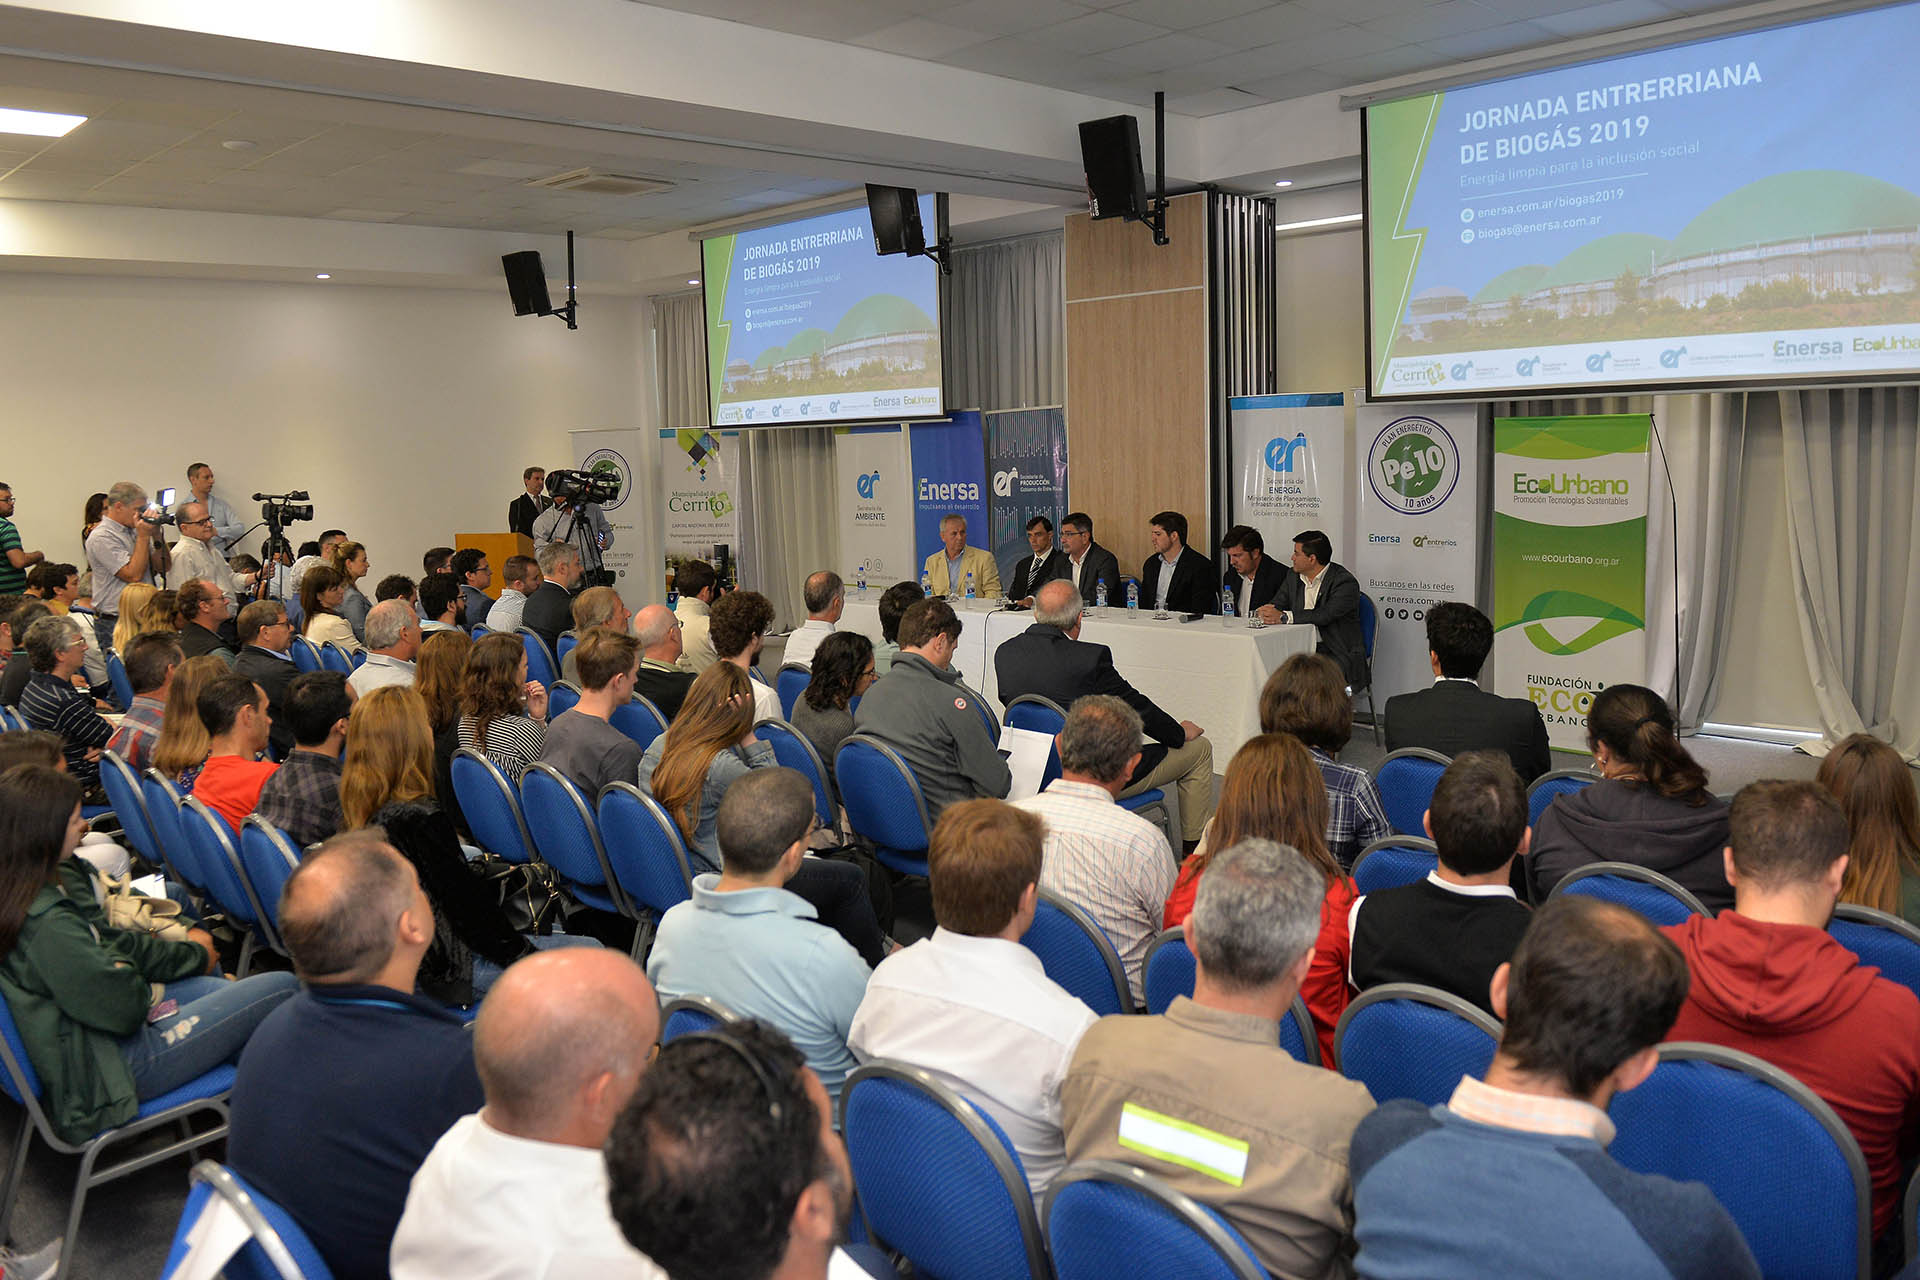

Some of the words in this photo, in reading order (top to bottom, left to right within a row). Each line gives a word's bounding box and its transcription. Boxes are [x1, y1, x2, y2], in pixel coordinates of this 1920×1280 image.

[1459, 96, 1569, 133] JORNADA
[1576, 61, 1762, 113] ENTRERRIANA
[1460, 141, 1489, 165] DE
[1496, 124, 1582, 160] BIOGÁS
[1590, 115, 1650, 144] 2019
[1460, 169, 1505, 188] Energía
[1508, 164, 1546, 182] limpia
[1550, 161, 1578, 176] para
[1582, 157, 1594, 169] la
[1597, 147, 1656, 167] inclusión
[1660, 139, 1701, 159] social
[1478, 215, 1602, 240] biogas@enersa.com.ar
[743, 240, 789, 261] JORNADA
[790, 226, 864, 252] ENTRERRIANA
[744, 267, 757, 281] DE
[758, 258, 794, 279] BIOGÁS
[796, 255, 821, 272] 2019
[1773, 340, 1843, 356] Enersa
[873, 396, 900, 407] Enersa
[1382, 431, 1397, 448] PLAN
[1397, 423, 1433, 435] ENERGÉTICO
[1381, 444, 1446, 486] Pe10
[919, 478, 979, 501] Enersa
[1268, 484, 1301, 494] ENERGÍA
[1513, 472, 1629, 495] EcoUrbano
[669, 497, 725, 512] Cerrito
[1405, 498, 1414, 508] 10
[1416, 494, 1436, 508] años
[1513, 495, 1546, 504] Promoción
[1586, 496, 1629, 506] Sustentables
[855, 513, 886, 521] AMBIENTE
[1368, 533, 1400, 543] Enersa
[1521, 553, 1619, 567] www.ecourbano.org.ar
[1369, 579, 1406, 588] Buscanos
[1420, 581, 1431, 589] las
[1432, 582, 1455, 591] redes
[1527, 674, 1592, 690] FUNDACIÓN
[1527, 686, 1595, 715] ECO
